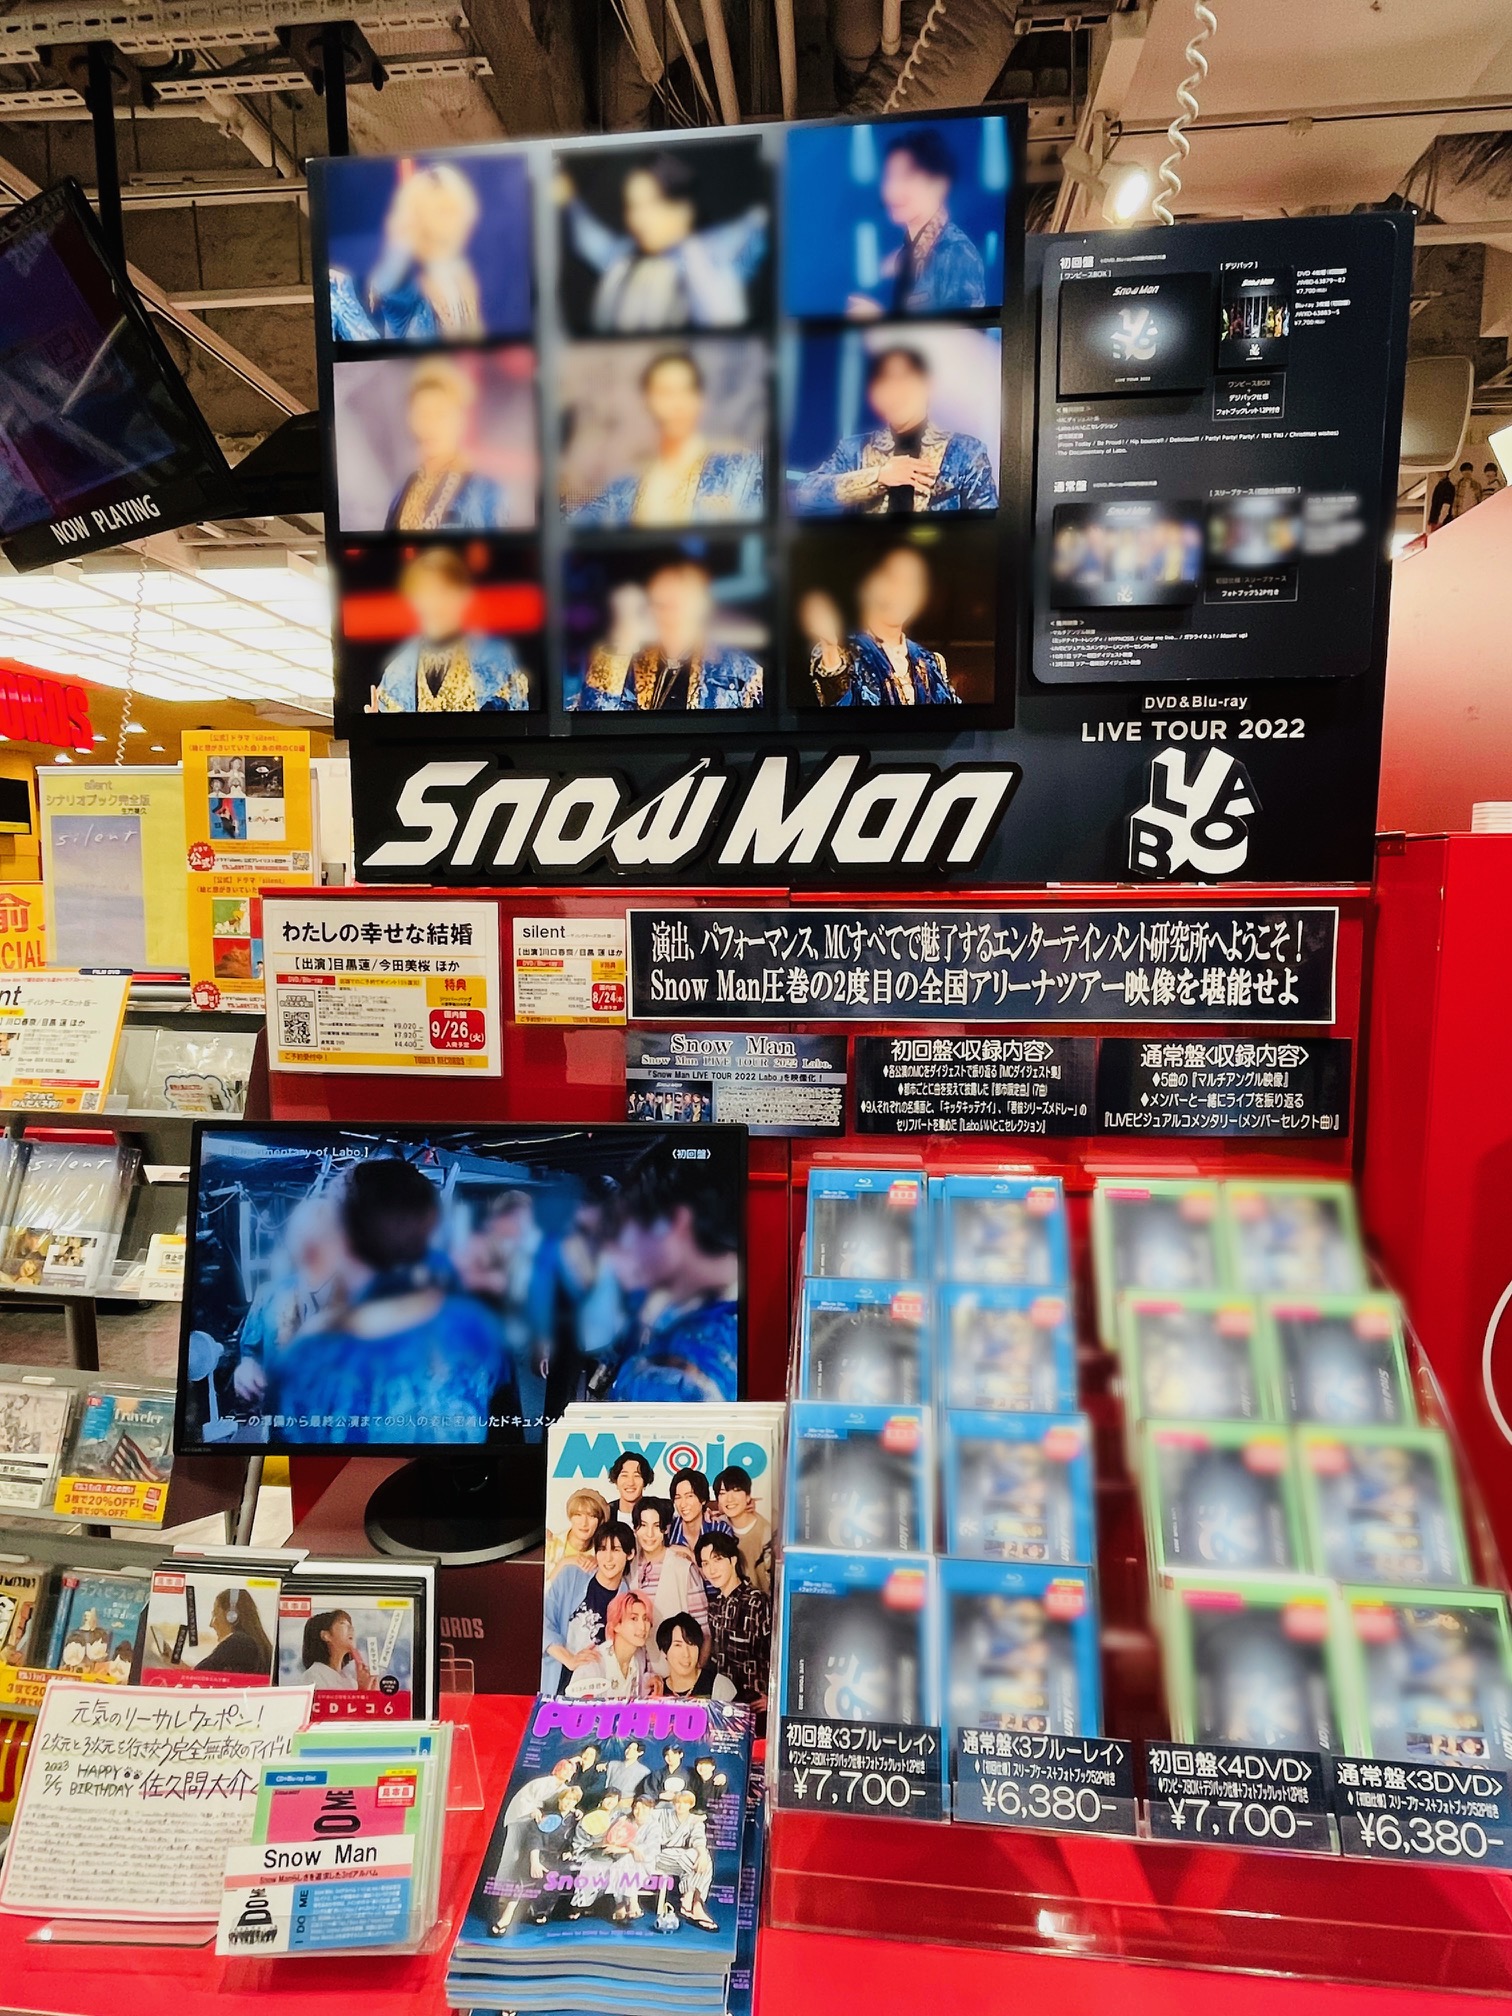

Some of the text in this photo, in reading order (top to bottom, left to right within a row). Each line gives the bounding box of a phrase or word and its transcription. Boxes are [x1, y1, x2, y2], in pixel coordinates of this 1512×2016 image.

[1060, 256, 1094, 269] 初回盤
[50, 494, 161, 546] NOW PLAYING
[1081, 718, 1306, 742] LIVE TOUR 2022
[362, 755, 1014, 867] Snow Man
[56, 824, 138, 848] silent
[283, 921, 472, 946] わたしの幸せな結婚
[523, 925, 566, 938] silent
[436, 960, 460, 972] ほか
[444, 978, 467, 991] 特典
[651, 968, 708, 1002] Snow
[670, 1034, 796, 1058] Snow Man
[642, 1055, 670, 1066] Snow
[674, 1056, 698, 1066] Man
[702, 1056, 730, 1067] LIVE
[737, 1057, 768, 1068] TOUR
[773, 1058, 797, 1069] 2022
[674, 1071, 690, 1079] Man
[692, 1071, 708, 1080] LIVE
[712, 1072, 732, 1080] TOUR
[735, 1072, 756, 1081] 2022
[28, 1151, 112, 1173] silent
[315, 1147, 327, 1157] of
[114, 1408, 163, 1424] Traveler
[71, 1699, 264, 1731] 元気のリーサルウェポン!
[532, 1702, 707, 1741] POTATO
[45, 1760, 122, 1780] 2023 HAPPY
[70, 1784, 133, 1796] BIRTHDAY
[264, 1844, 377, 1868] Snow Man
[544, 1870, 612, 1892] Snow
[619, 1870, 674, 1890] Man
